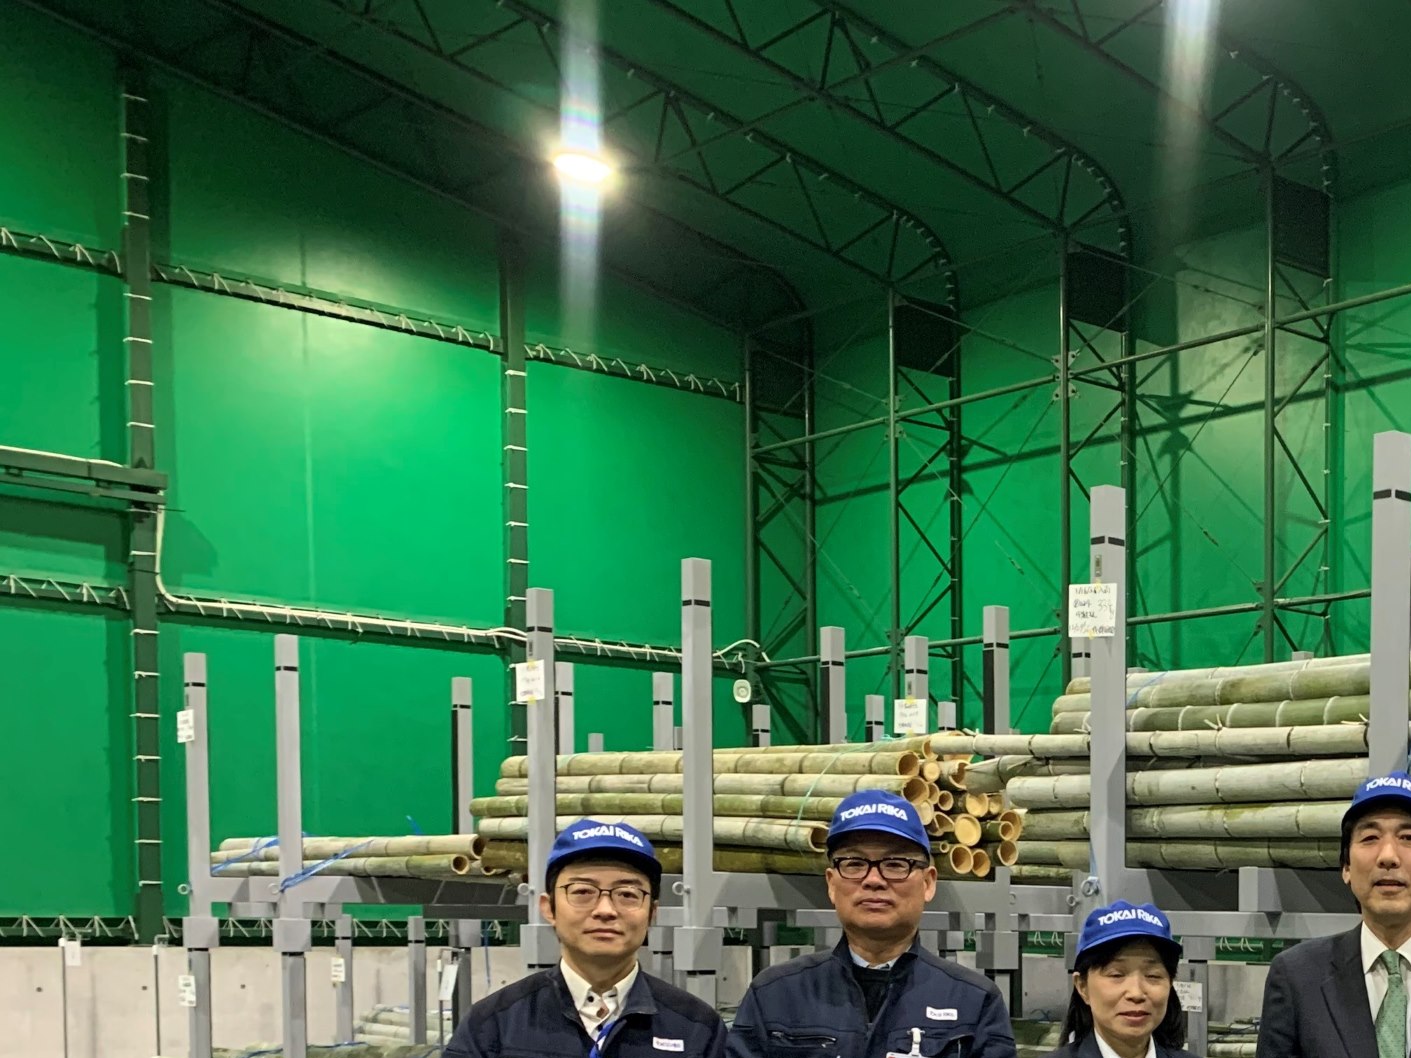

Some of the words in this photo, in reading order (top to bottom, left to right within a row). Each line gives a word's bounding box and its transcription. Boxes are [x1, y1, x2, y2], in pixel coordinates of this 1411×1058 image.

[1366, 777, 1401, 791] TOKAI
[840, 803, 876, 821] TOKAI
[877, 803, 908, 821] RIKA
[572, 825, 614, 840] TOKAI
[615, 827, 644, 847] RIKA
[1098, 909, 1136, 926] TOKAI
[1137, 909, 1163, 928] RIKA
